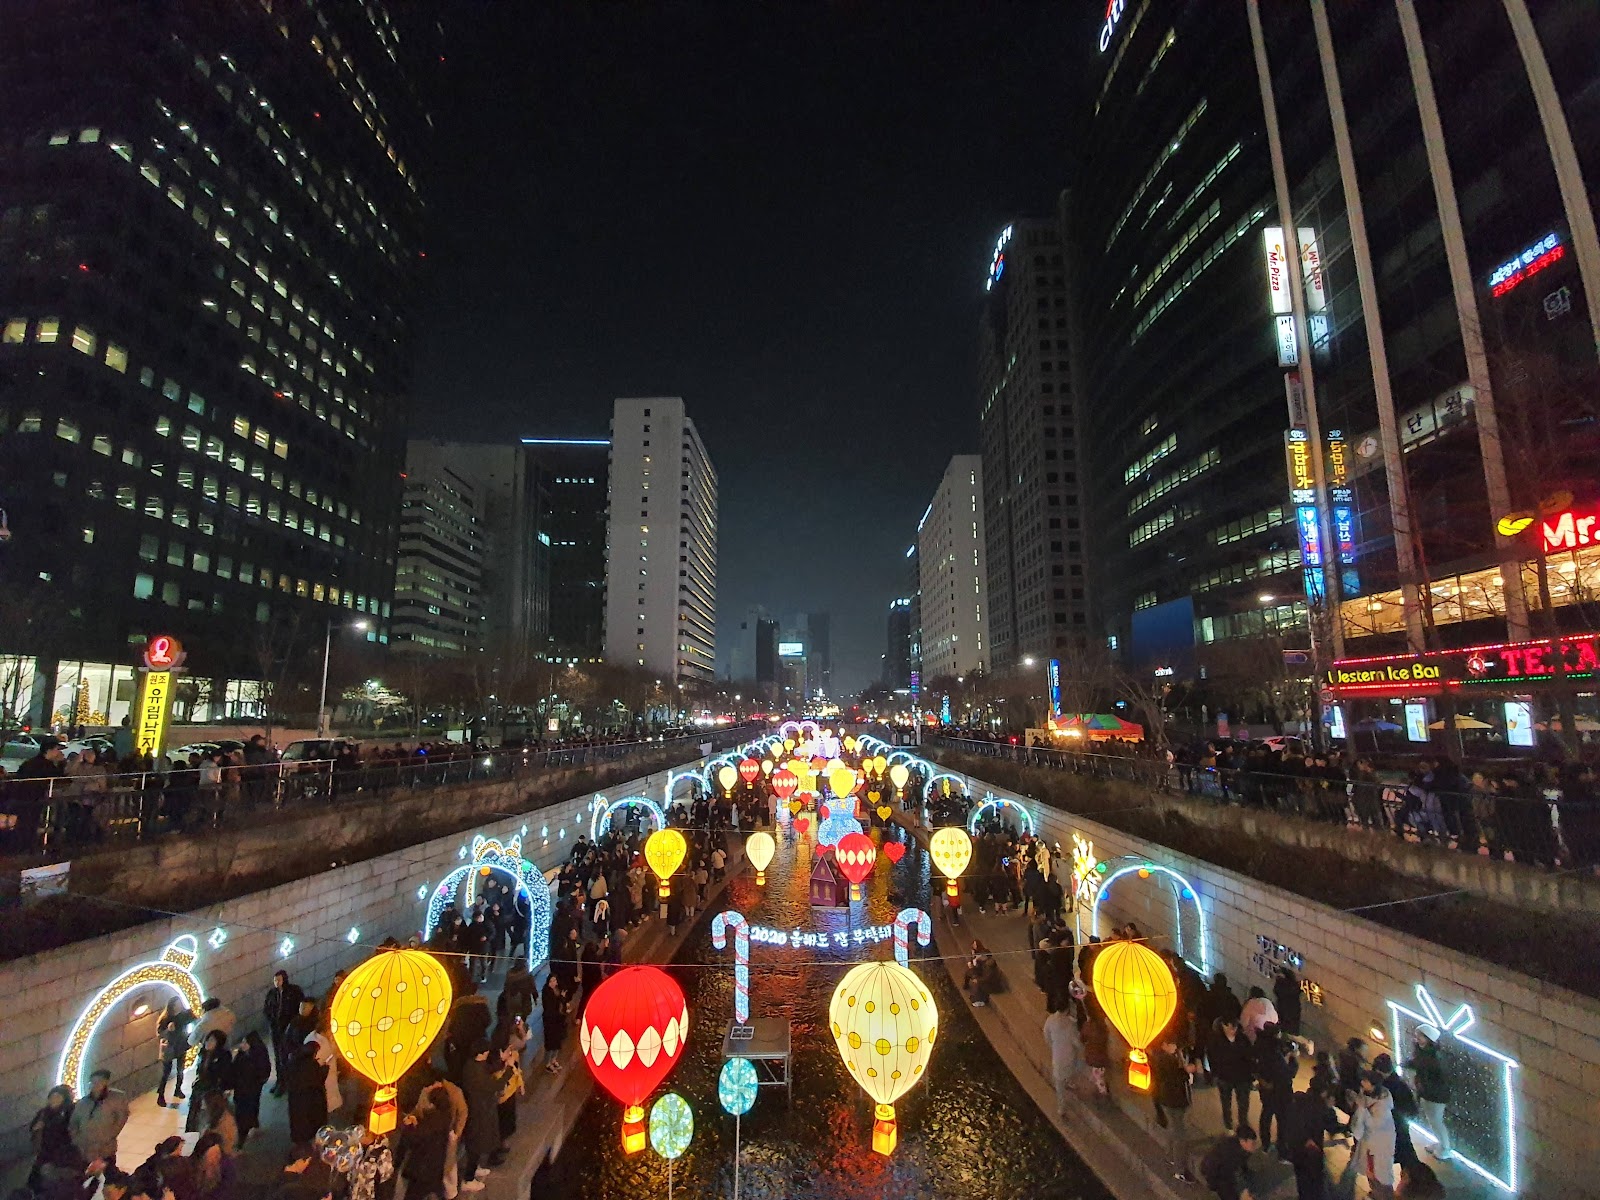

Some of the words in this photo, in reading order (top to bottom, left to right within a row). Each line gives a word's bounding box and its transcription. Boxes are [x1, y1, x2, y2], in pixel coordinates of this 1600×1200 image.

[1500, 642, 1600, 676] TEA
[150, 674, 167, 685] 원조
[1386, 664, 1410, 680] Ice
[141, 688, 163, 749] 유림낙지
[749, 926, 788, 945] 2020
[790, 927, 829, 947] 올해도
[833, 932, 849, 947] 잘
[853, 925, 892, 944] 부탁해
[1299, 979, 1324, 1007] 서울
